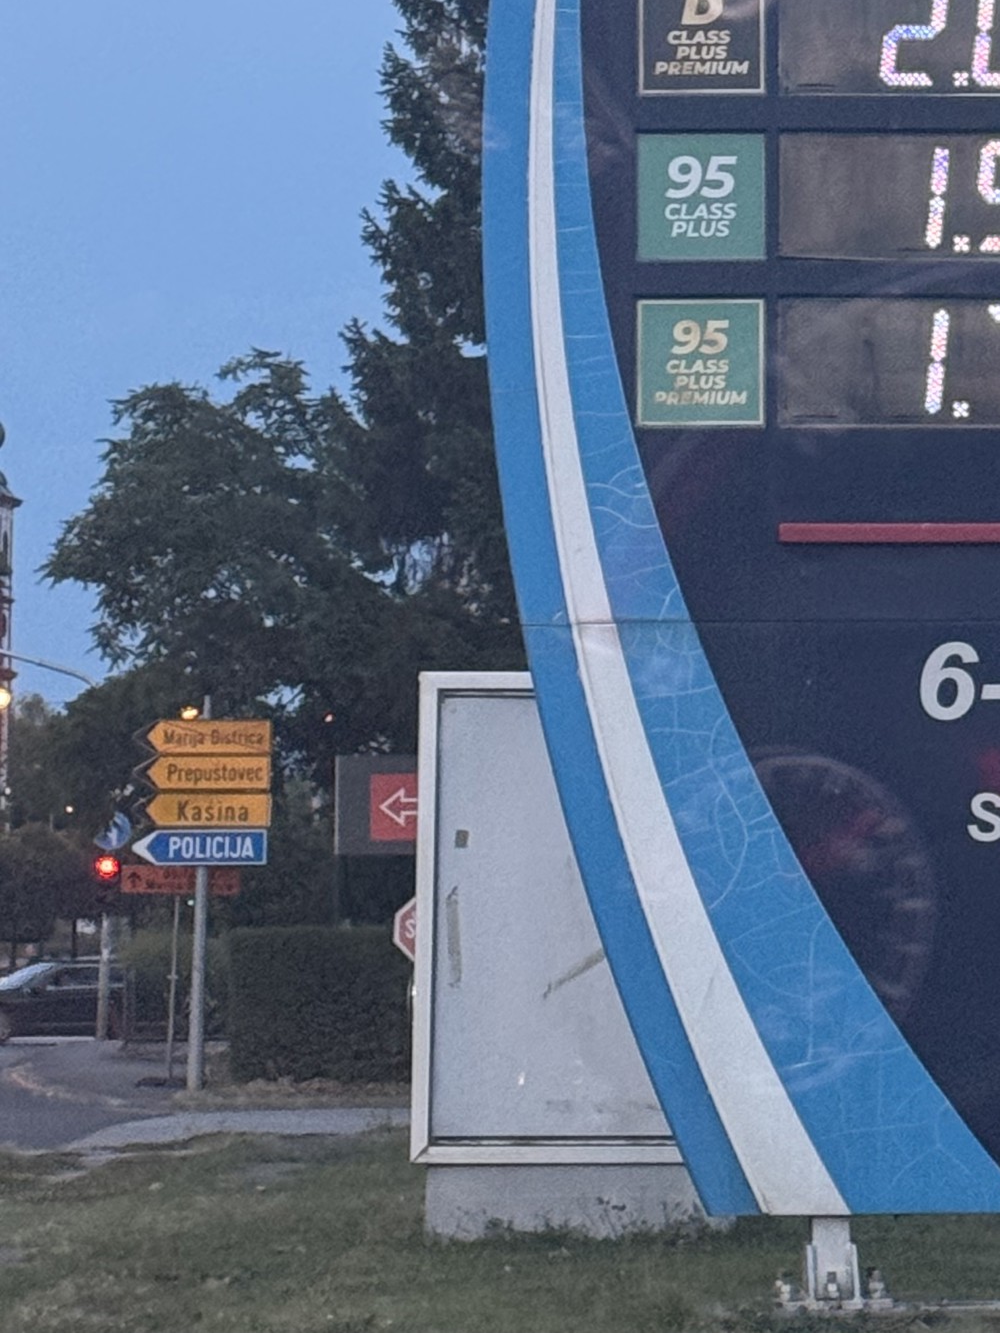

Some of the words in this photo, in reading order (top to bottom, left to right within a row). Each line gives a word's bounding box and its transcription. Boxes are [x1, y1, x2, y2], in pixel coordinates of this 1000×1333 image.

[667, 30, 731, 44] CLASS
[676, 45, 727, 59] PLUS
[654, 61, 749, 74] PREMIUM
[665, 156, 737, 198] 95
[664, 203, 737, 220] CLASS
[671, 221, 730, 237] PLUS
[671, 320, 729, 354] 95
[666, 360, 729, 373] CLASS
[674, 375, 726, 389] PLUS
[655, 391, 747, 405] PREMIUM
[163, 729, 205, 748] Marija
[167, 763, 263, 786] Prepustovec
[168, 836, 254, 859] POLICIJA
